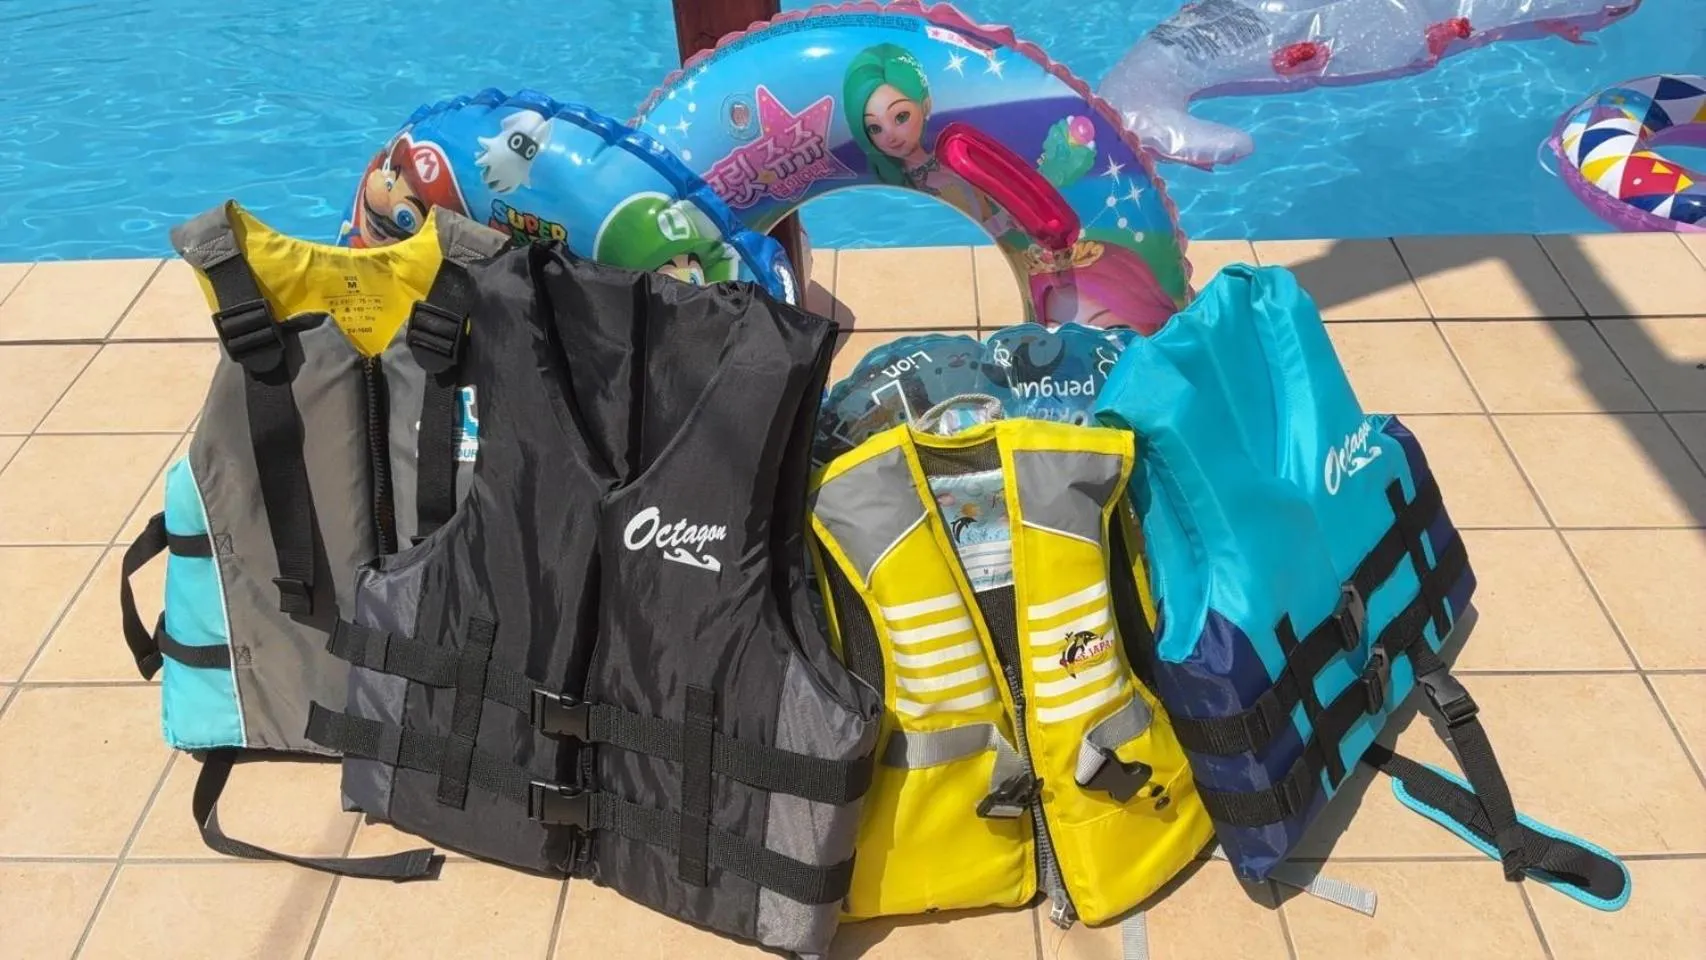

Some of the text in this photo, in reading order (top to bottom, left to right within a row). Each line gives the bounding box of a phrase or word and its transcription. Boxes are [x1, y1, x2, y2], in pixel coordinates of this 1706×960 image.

[491, 198, 568, 241] SUPER
[347, 281, 357, 289] M
[881, 350, 933, 378] Lion
[1324, 419, 1372, 496] Octagon
[623, 506, 727, 553] Octagon
